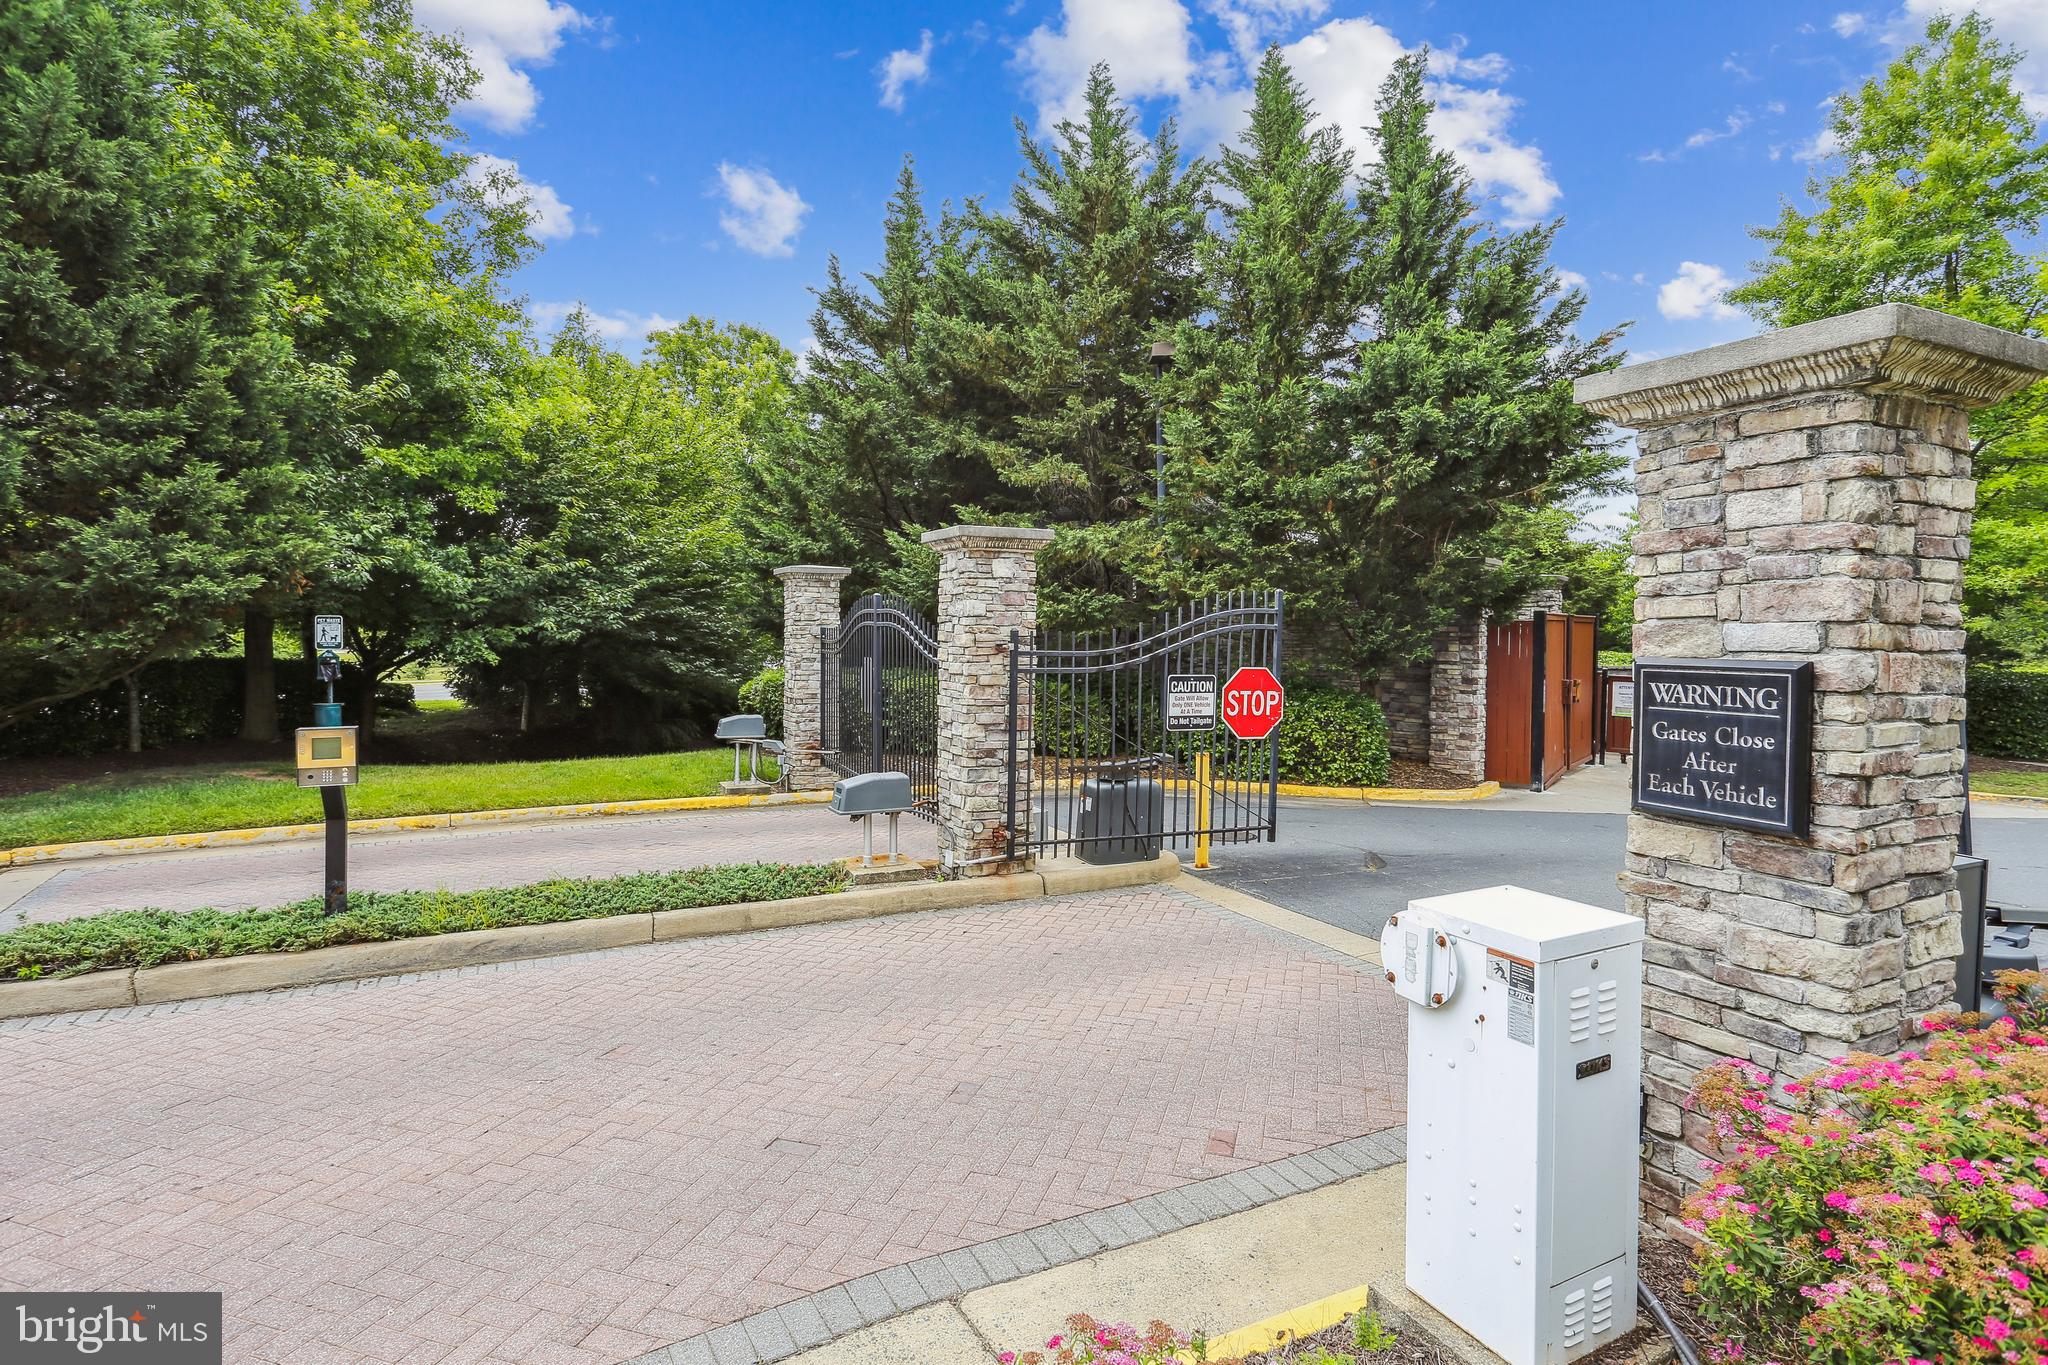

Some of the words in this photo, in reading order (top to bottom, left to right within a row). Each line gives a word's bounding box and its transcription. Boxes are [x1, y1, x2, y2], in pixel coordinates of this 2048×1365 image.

[1171, 681, 1213, 692] CAUTION
[1649, 682, 1778, 710] WARNING
[1226, 690, 1279, 716] STOP
[1190, 717, 1212, 725] Tailgate
[1652, 721, 1707, 743] Gates
[1714, 727, 1775, 750] Close
[1682, 751, 1737, 775] After
[1648, 773, 1695, 797] Each
[1700, 779, 1777, 809] Vehicle
